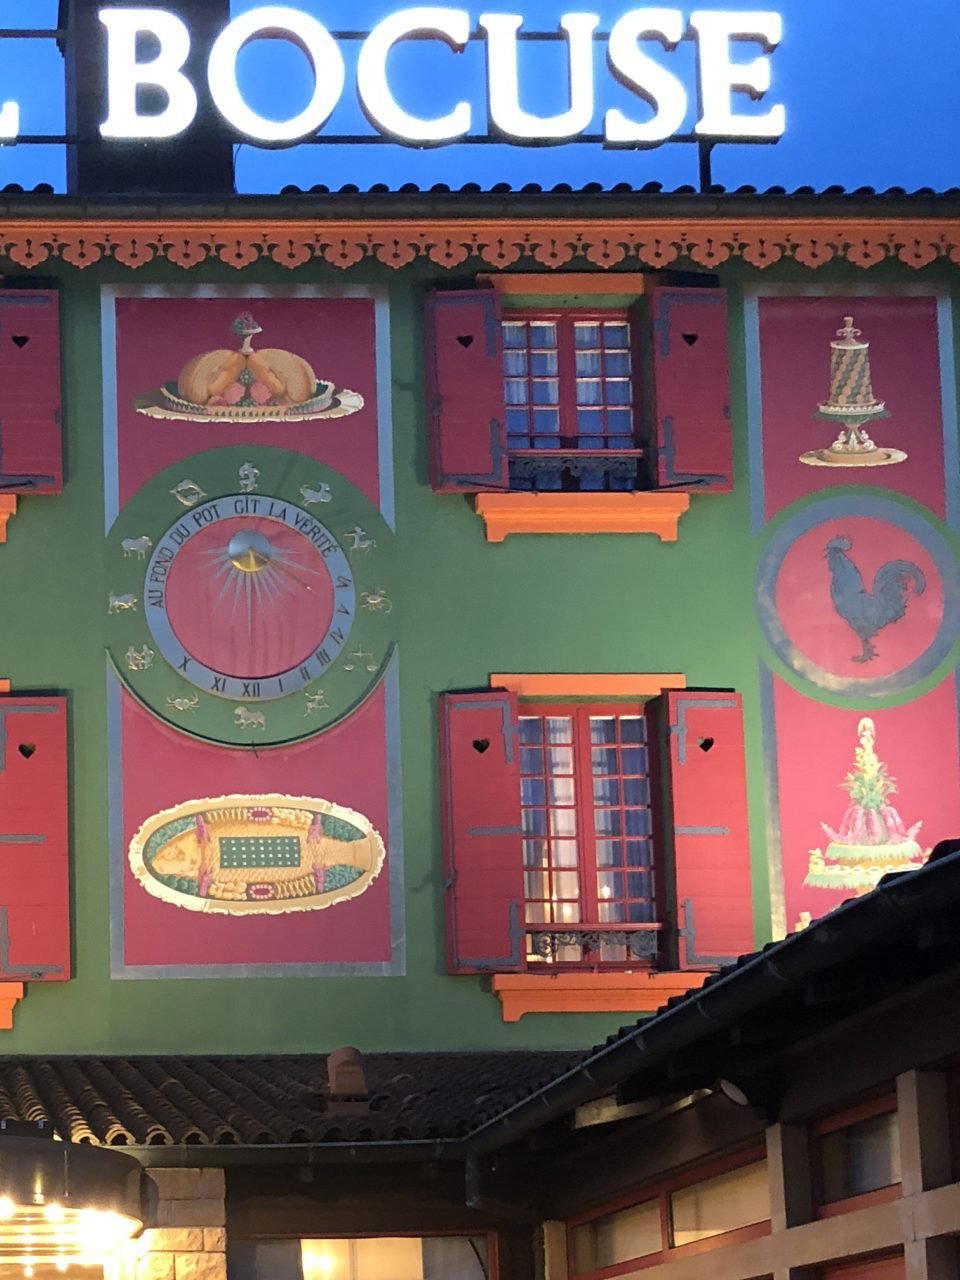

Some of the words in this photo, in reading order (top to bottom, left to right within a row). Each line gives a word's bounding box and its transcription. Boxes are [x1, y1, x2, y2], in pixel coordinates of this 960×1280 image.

[97, 4, 787, 147] BOCUSE
[193, 504, 221, 527] POT
[269, 502, 287, 521] LA
[169, 524, 191, 545] DU
[150, 547, 174, 583] FOND
[148, 589, 164, 609] AU
[178, 656, 191, 672] X
[211, 676, 227, 692] XI
[242, 682, 260, 697] XII
[300, 666, 311, 681] II
